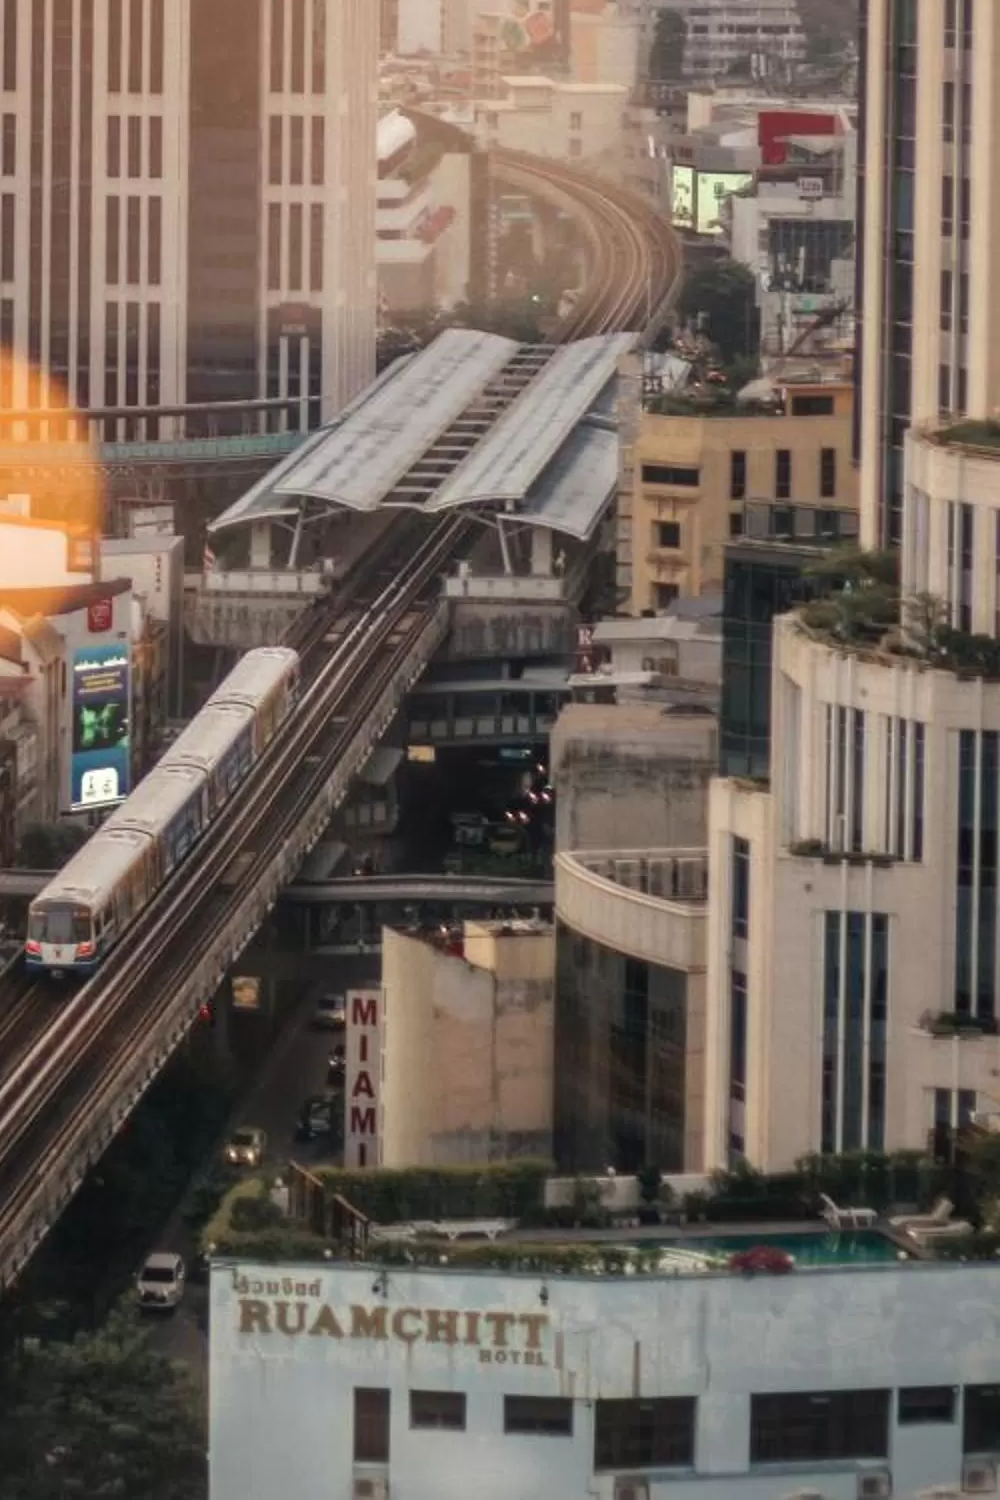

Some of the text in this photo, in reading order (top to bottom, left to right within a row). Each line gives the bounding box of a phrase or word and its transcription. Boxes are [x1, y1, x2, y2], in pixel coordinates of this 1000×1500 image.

[351, 997, 378, 1167] MIAMI
[239, 1299, 549, 1349] RUAMCHITT
[479, 1349, 548, 1367] HOTEL
